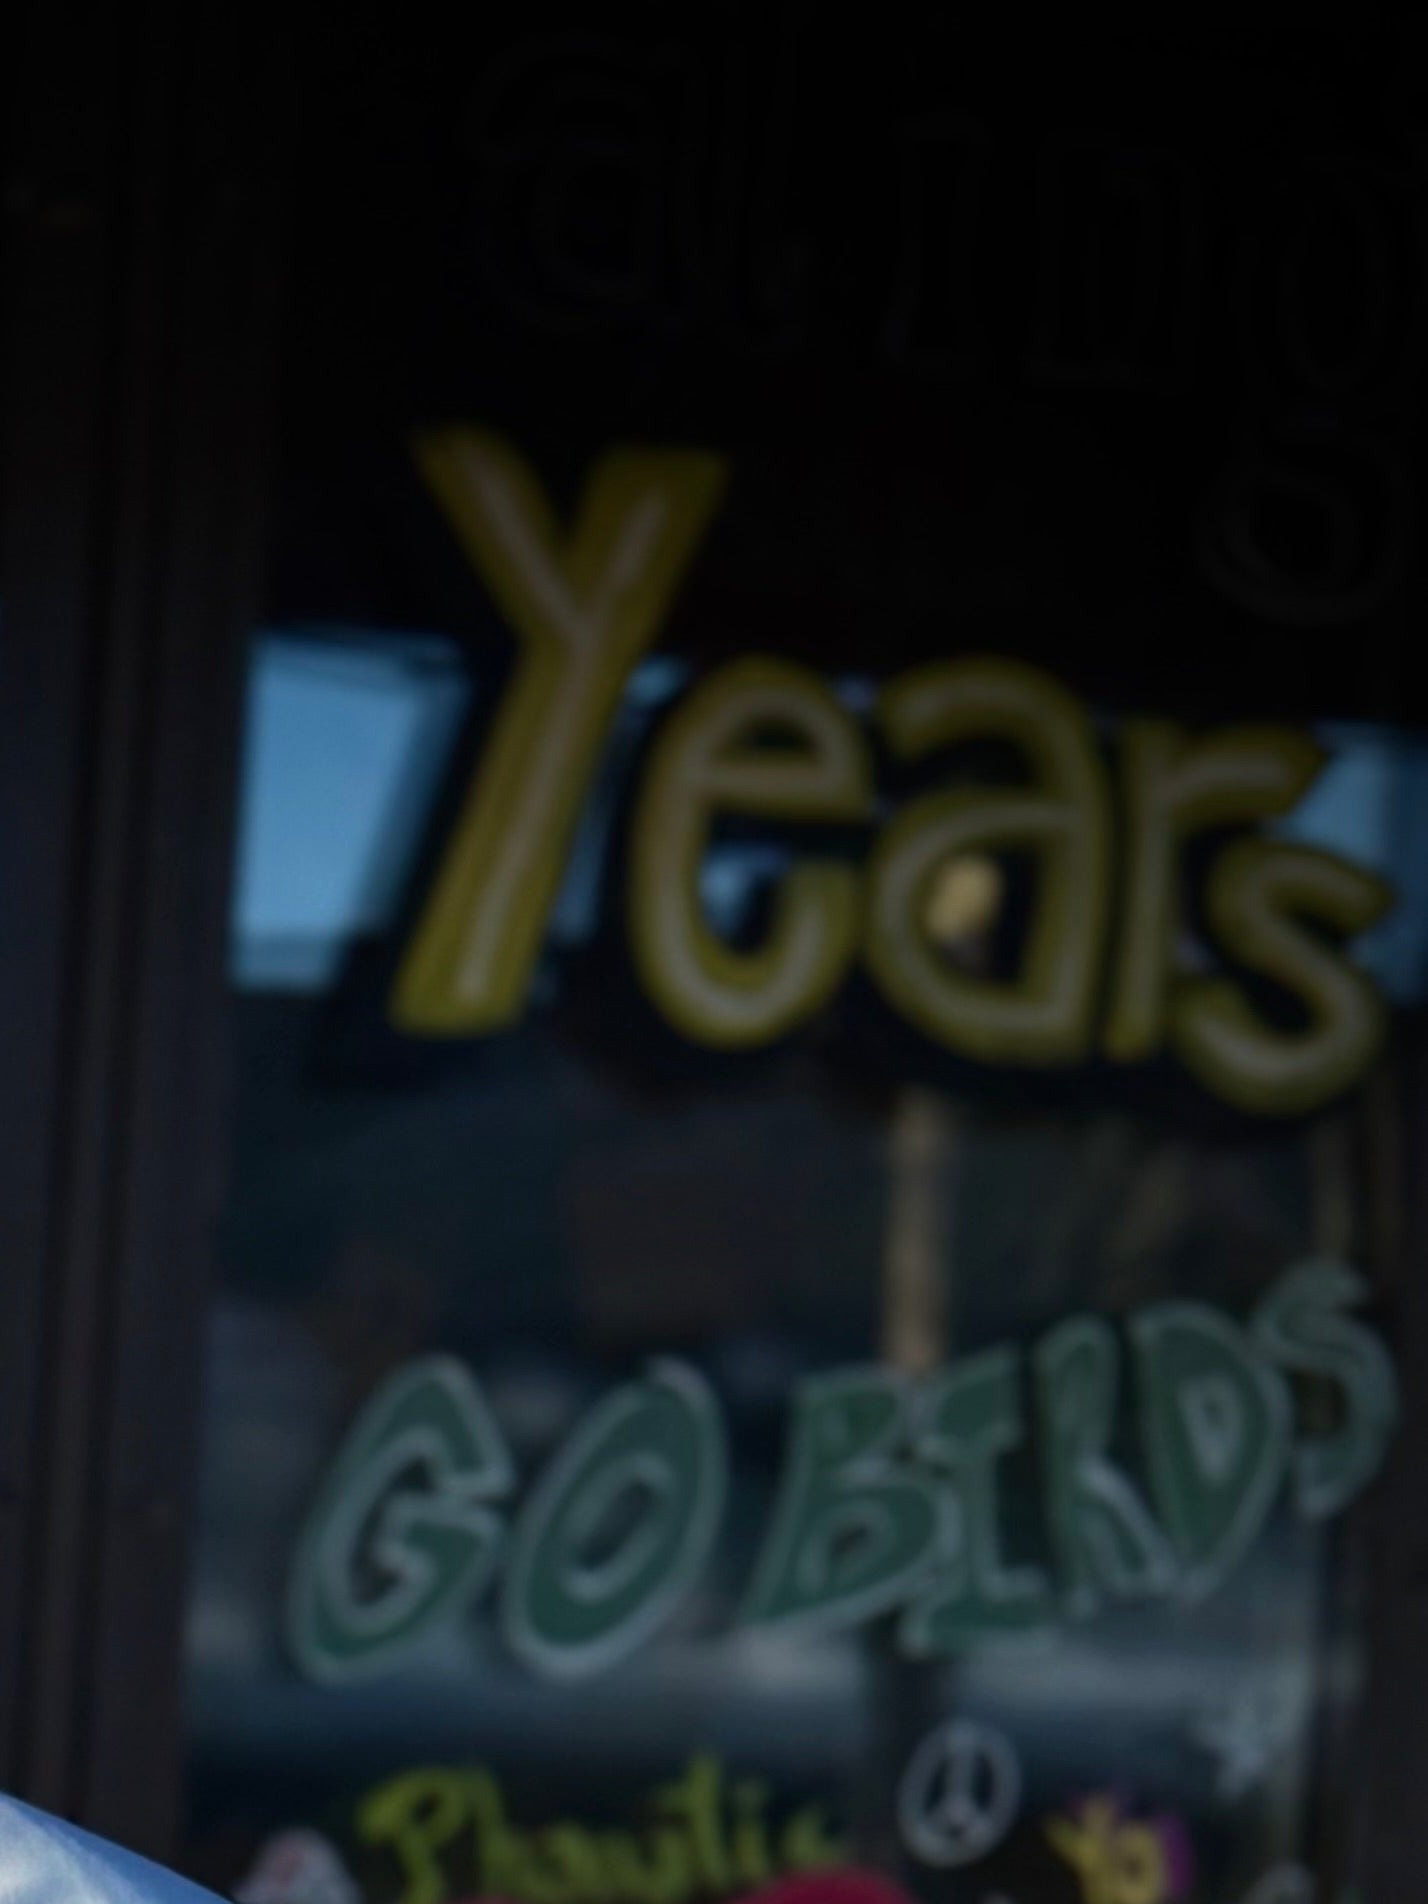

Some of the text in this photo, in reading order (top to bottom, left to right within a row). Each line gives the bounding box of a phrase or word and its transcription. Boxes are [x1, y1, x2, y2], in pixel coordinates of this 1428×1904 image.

[387, 420, 1399, 1113] Years
[292, 1256, 1400, 1684] GO BIRDS
